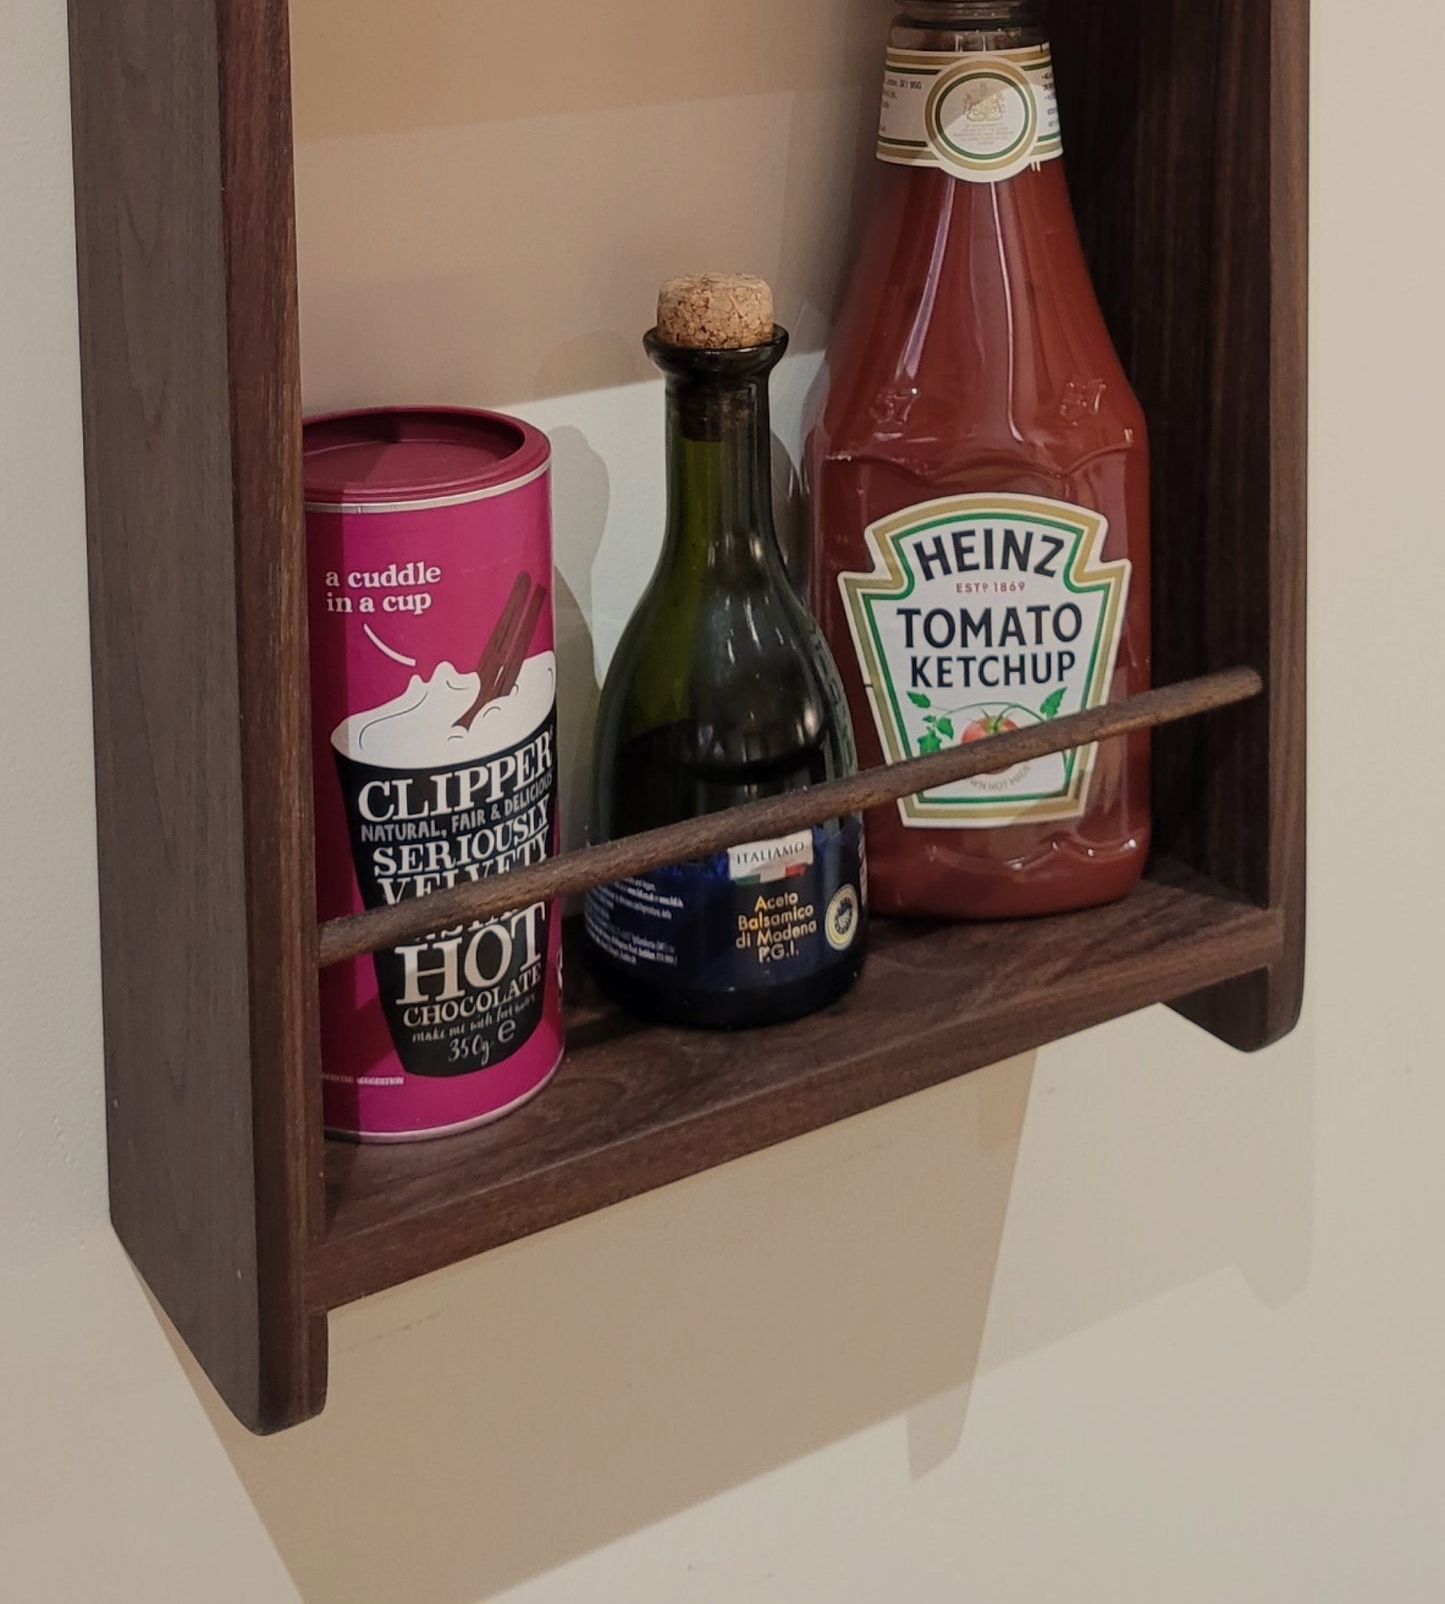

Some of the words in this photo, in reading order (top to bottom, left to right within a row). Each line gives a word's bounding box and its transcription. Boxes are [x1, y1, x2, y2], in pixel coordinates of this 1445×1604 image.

[912, 527, 1065, 581] HEINZ
[325, 570, 340, 587] a
[347, 561, 442, 588] cuddle
[993, 580, 1026, 593] 1869
[326, 592, 353, 613] in
[359, 596, 375, 613] a
[382, 591, 432, 615] cup
[896, 602, 1082, 648] TOMATO
[910, 650, 1076, 688] KETCHUP
[358, 734, 552, 822] CLIPPER
[360, 819, 447, 842] NATURAL,
[451, 809, 486, 833] FAIR
[490, 804, 501, 818] &
[373, 794, 549, 878] SERIOUSLY
[376, 826, 550, 906] VEVETY
[736, 840, 805, 866] ITALIAMO
[738, 903, 814, 932] Balsamico
[754, 891, 799, 912] Aceto
[735, 933, 751, 949] di
[756, 919, 817, 946] Modena
[395, 900, 546, 1005] HOT
[758, 940, 799, 964] P.G.I.
[403, 963, 542, 1028] CHOCOLATE
[412, 1028, 445, 1044] make
[449, 1023, 466, 1037] me
[470, 1012, 493, 1031] with
